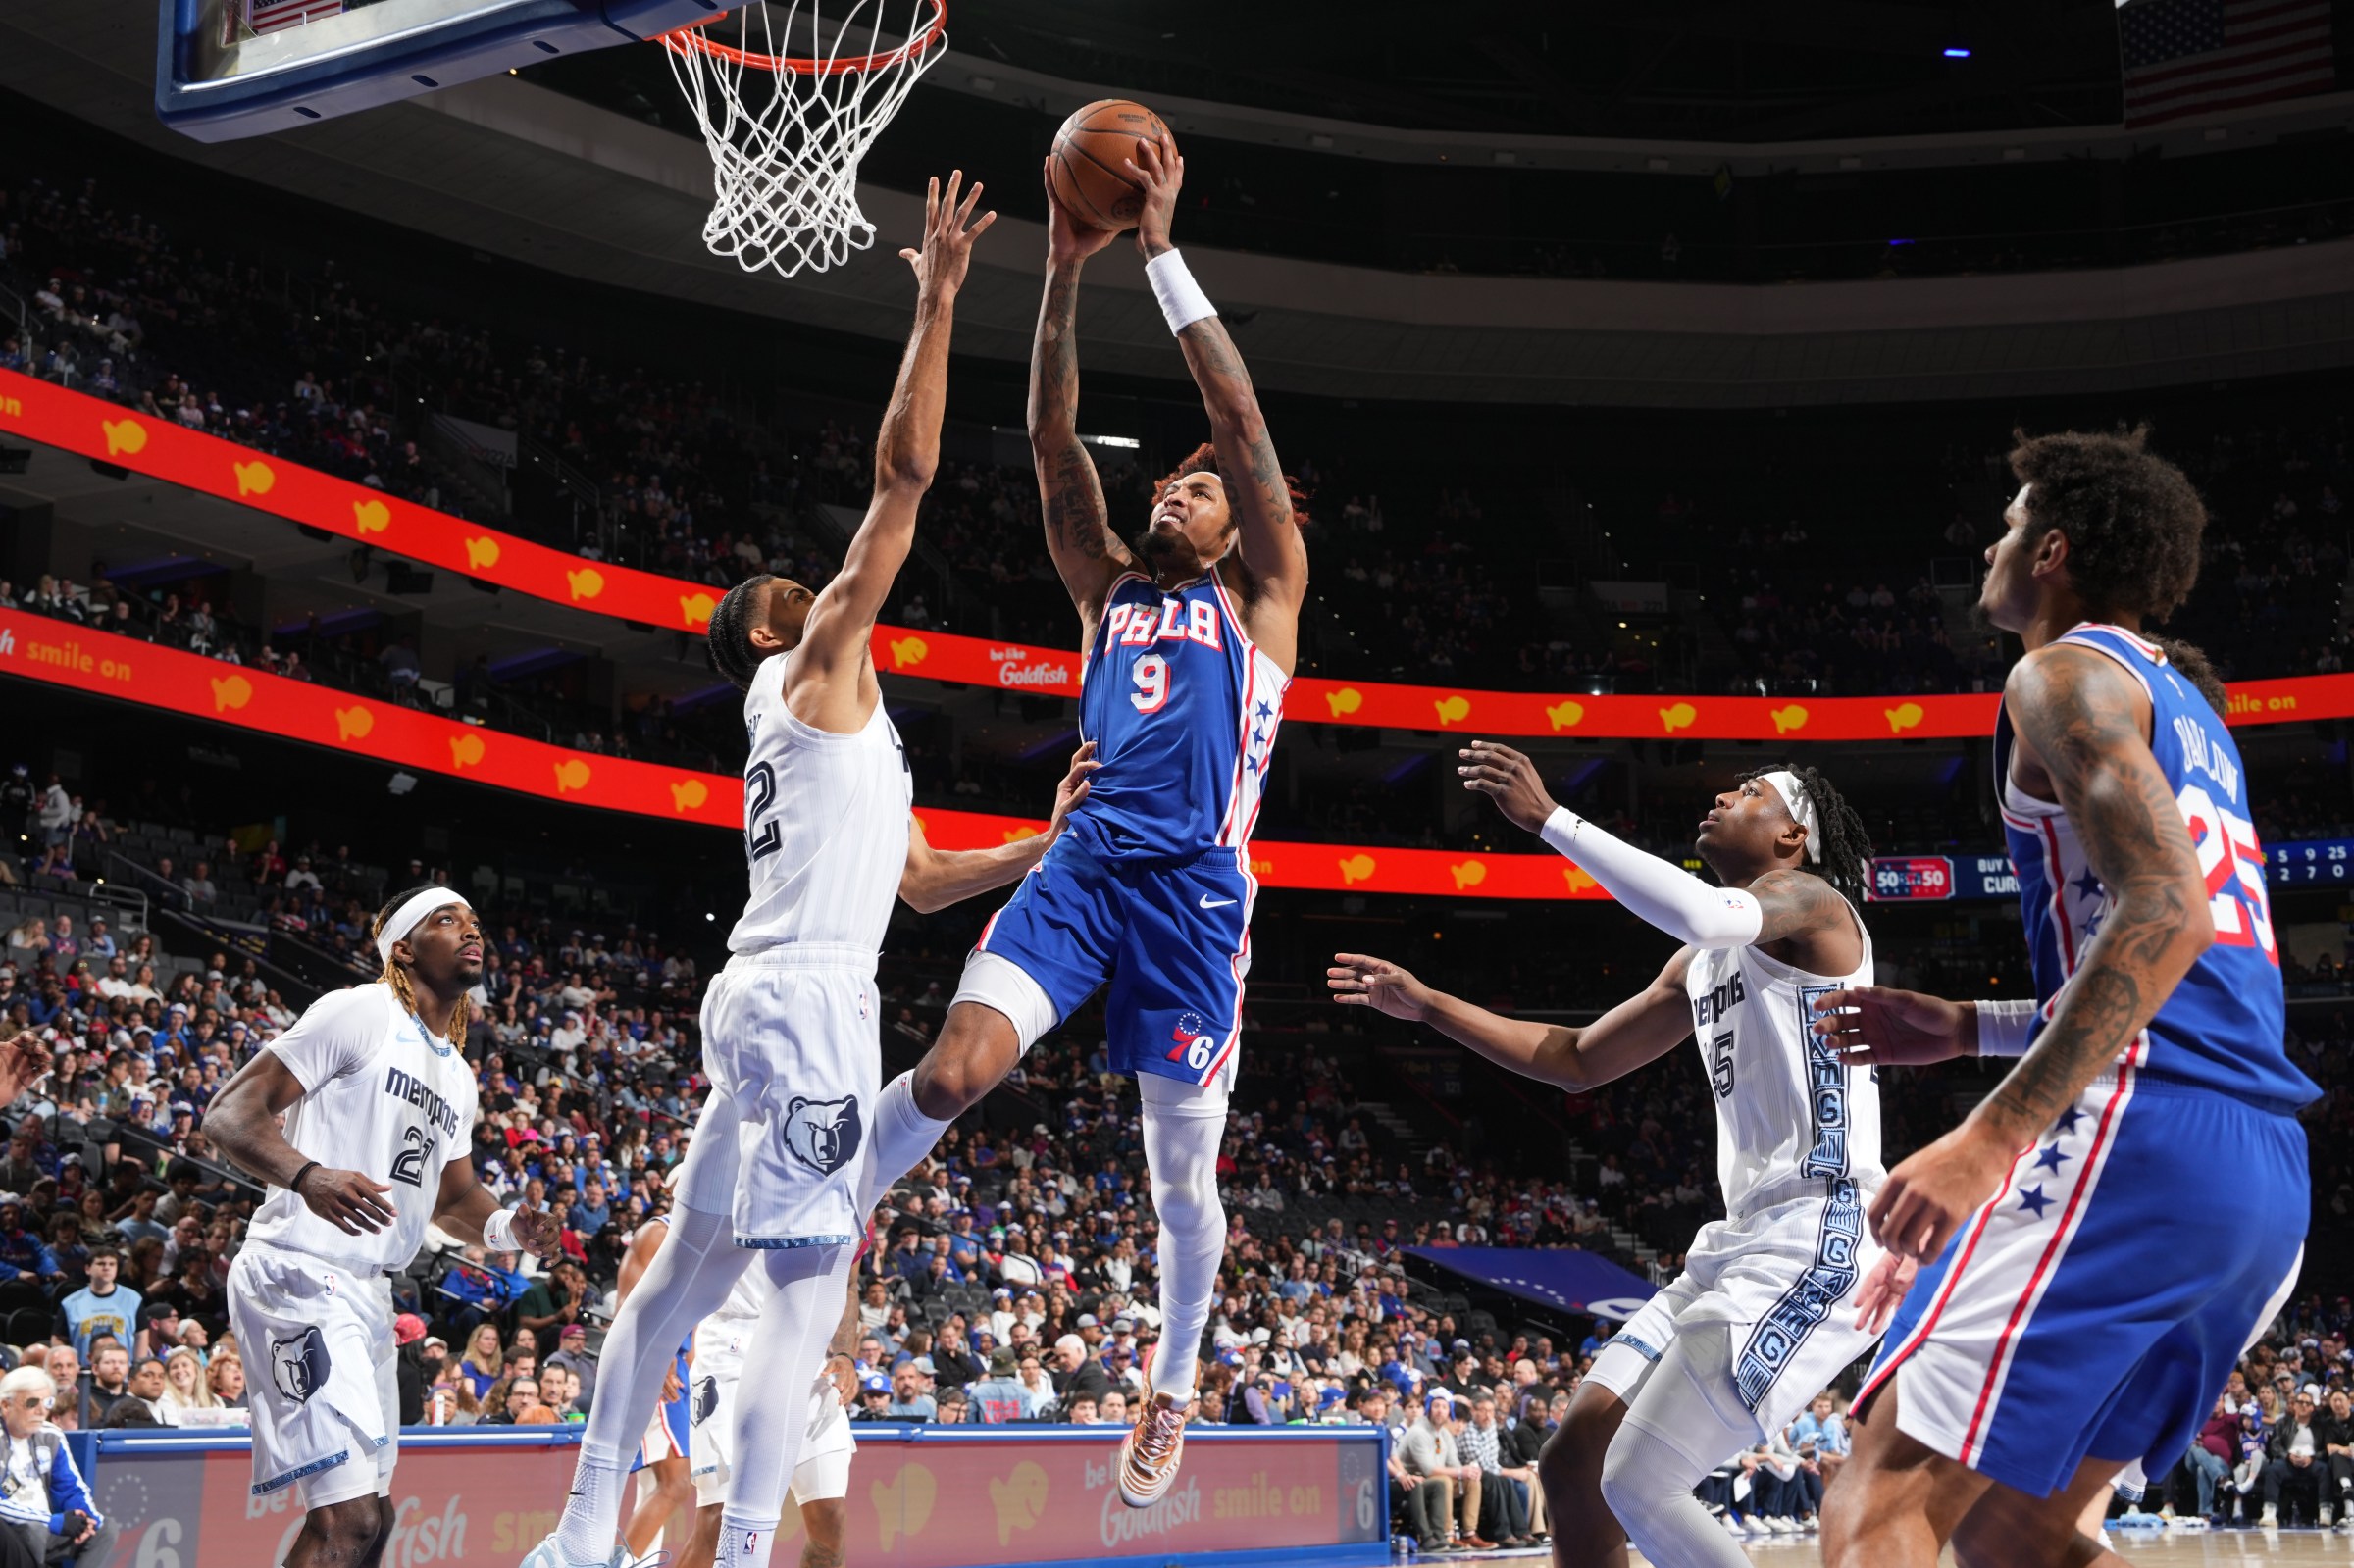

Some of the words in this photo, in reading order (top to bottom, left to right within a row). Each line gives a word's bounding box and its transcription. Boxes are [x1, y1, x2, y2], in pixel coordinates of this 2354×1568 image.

[1104, 597, 1223, 657] PHLA
[26, 641, 94, 673] smile
[100, 659, 132, 682] on
[990, 648, 1004, 661] be
[999, 661, 1069, 686] Goldfish
[1130, 653, 1171, 715] 9
[2268, 696, 2296, 711] on
[1977, 859, 2003, 873] BUY
[2277, 849, 2288, 863] 5
[2305, 847, 2316, 861] 9
[2328, 846, 2347, 860] 25
[1876, 871, 1899, 888] 50
[1922, 870, 1944, 886] 50
[2175, 784, 2280, 969] 25
[2280, 867, 2290, 881] 2
[2306, 866, 2316, 879] 7
[2332, 864, 2344, 878] 0
[1165, 1026, 1214, 1070] 76
[385, 1066, 459, 1139] memphis
[1085, 1459, 1106, 1490] be
[1213, 1473, 1283, 1519] smile
[1289, 1483, 1321, 1515] on
